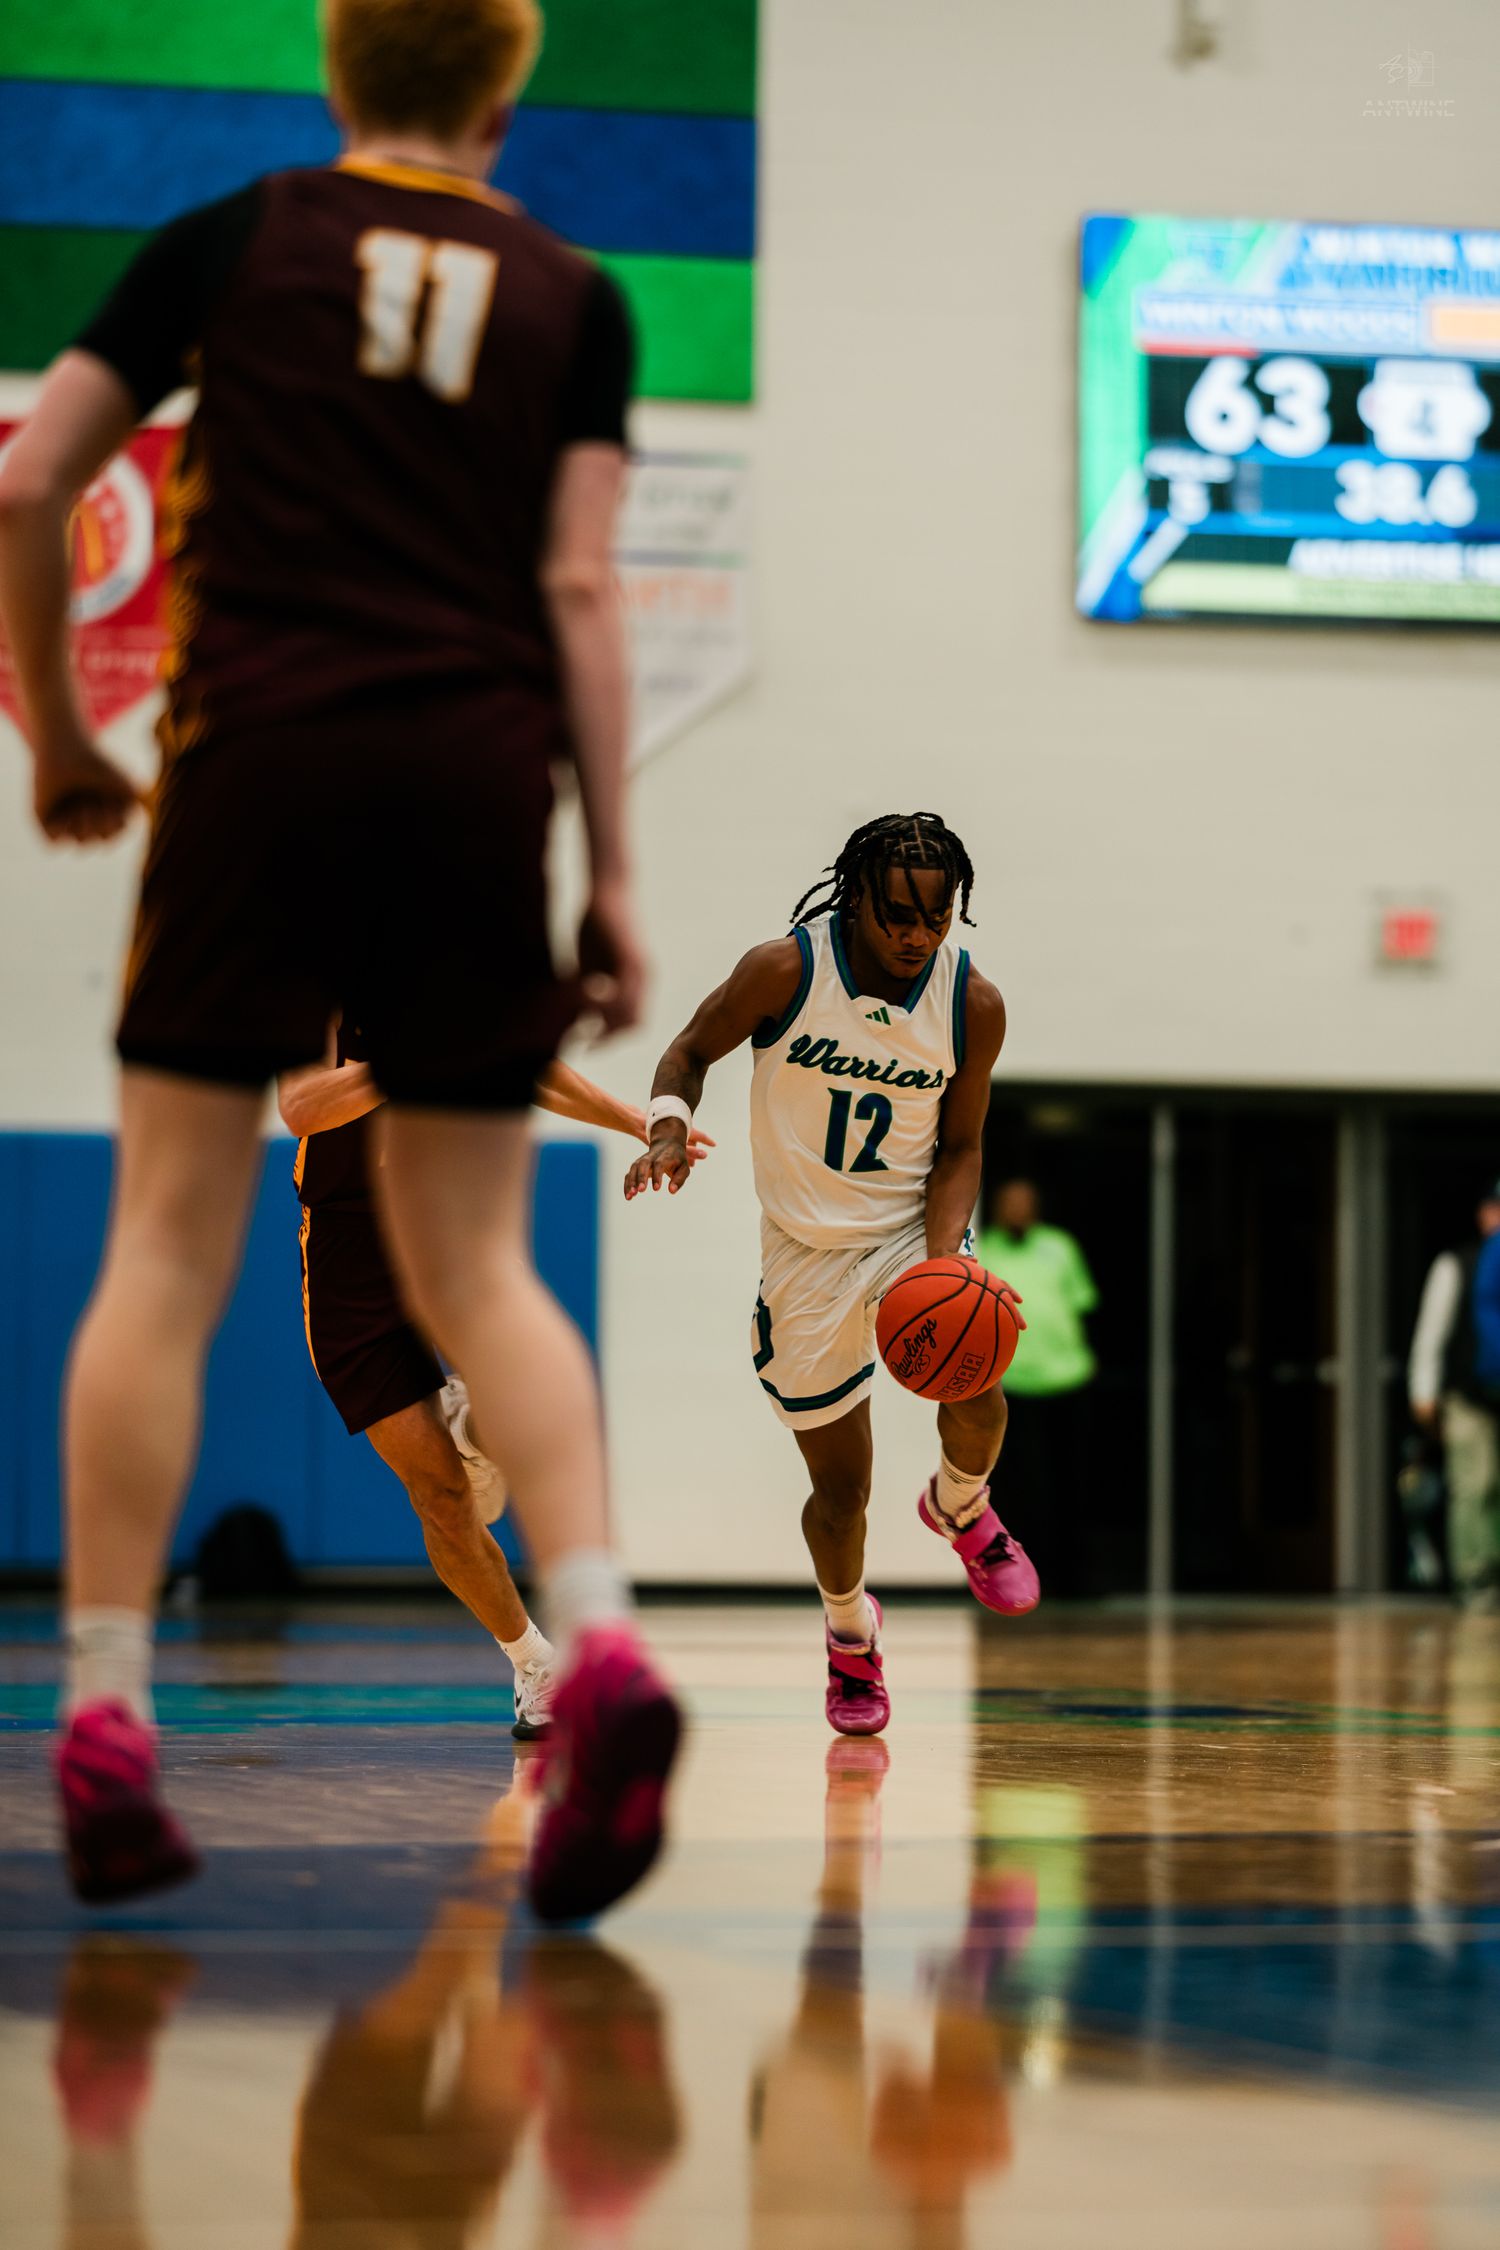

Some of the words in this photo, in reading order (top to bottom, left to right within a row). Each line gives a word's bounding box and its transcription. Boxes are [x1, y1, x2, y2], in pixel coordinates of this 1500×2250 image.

[354, 226, 499, 404] 11
[1187, 358, 1330, 456] 63
[786, 1034, 943, 1089] Warriors
[824, 1087, 892, 1172] 12
[891, 1317, 937, 1385] Rawlings
